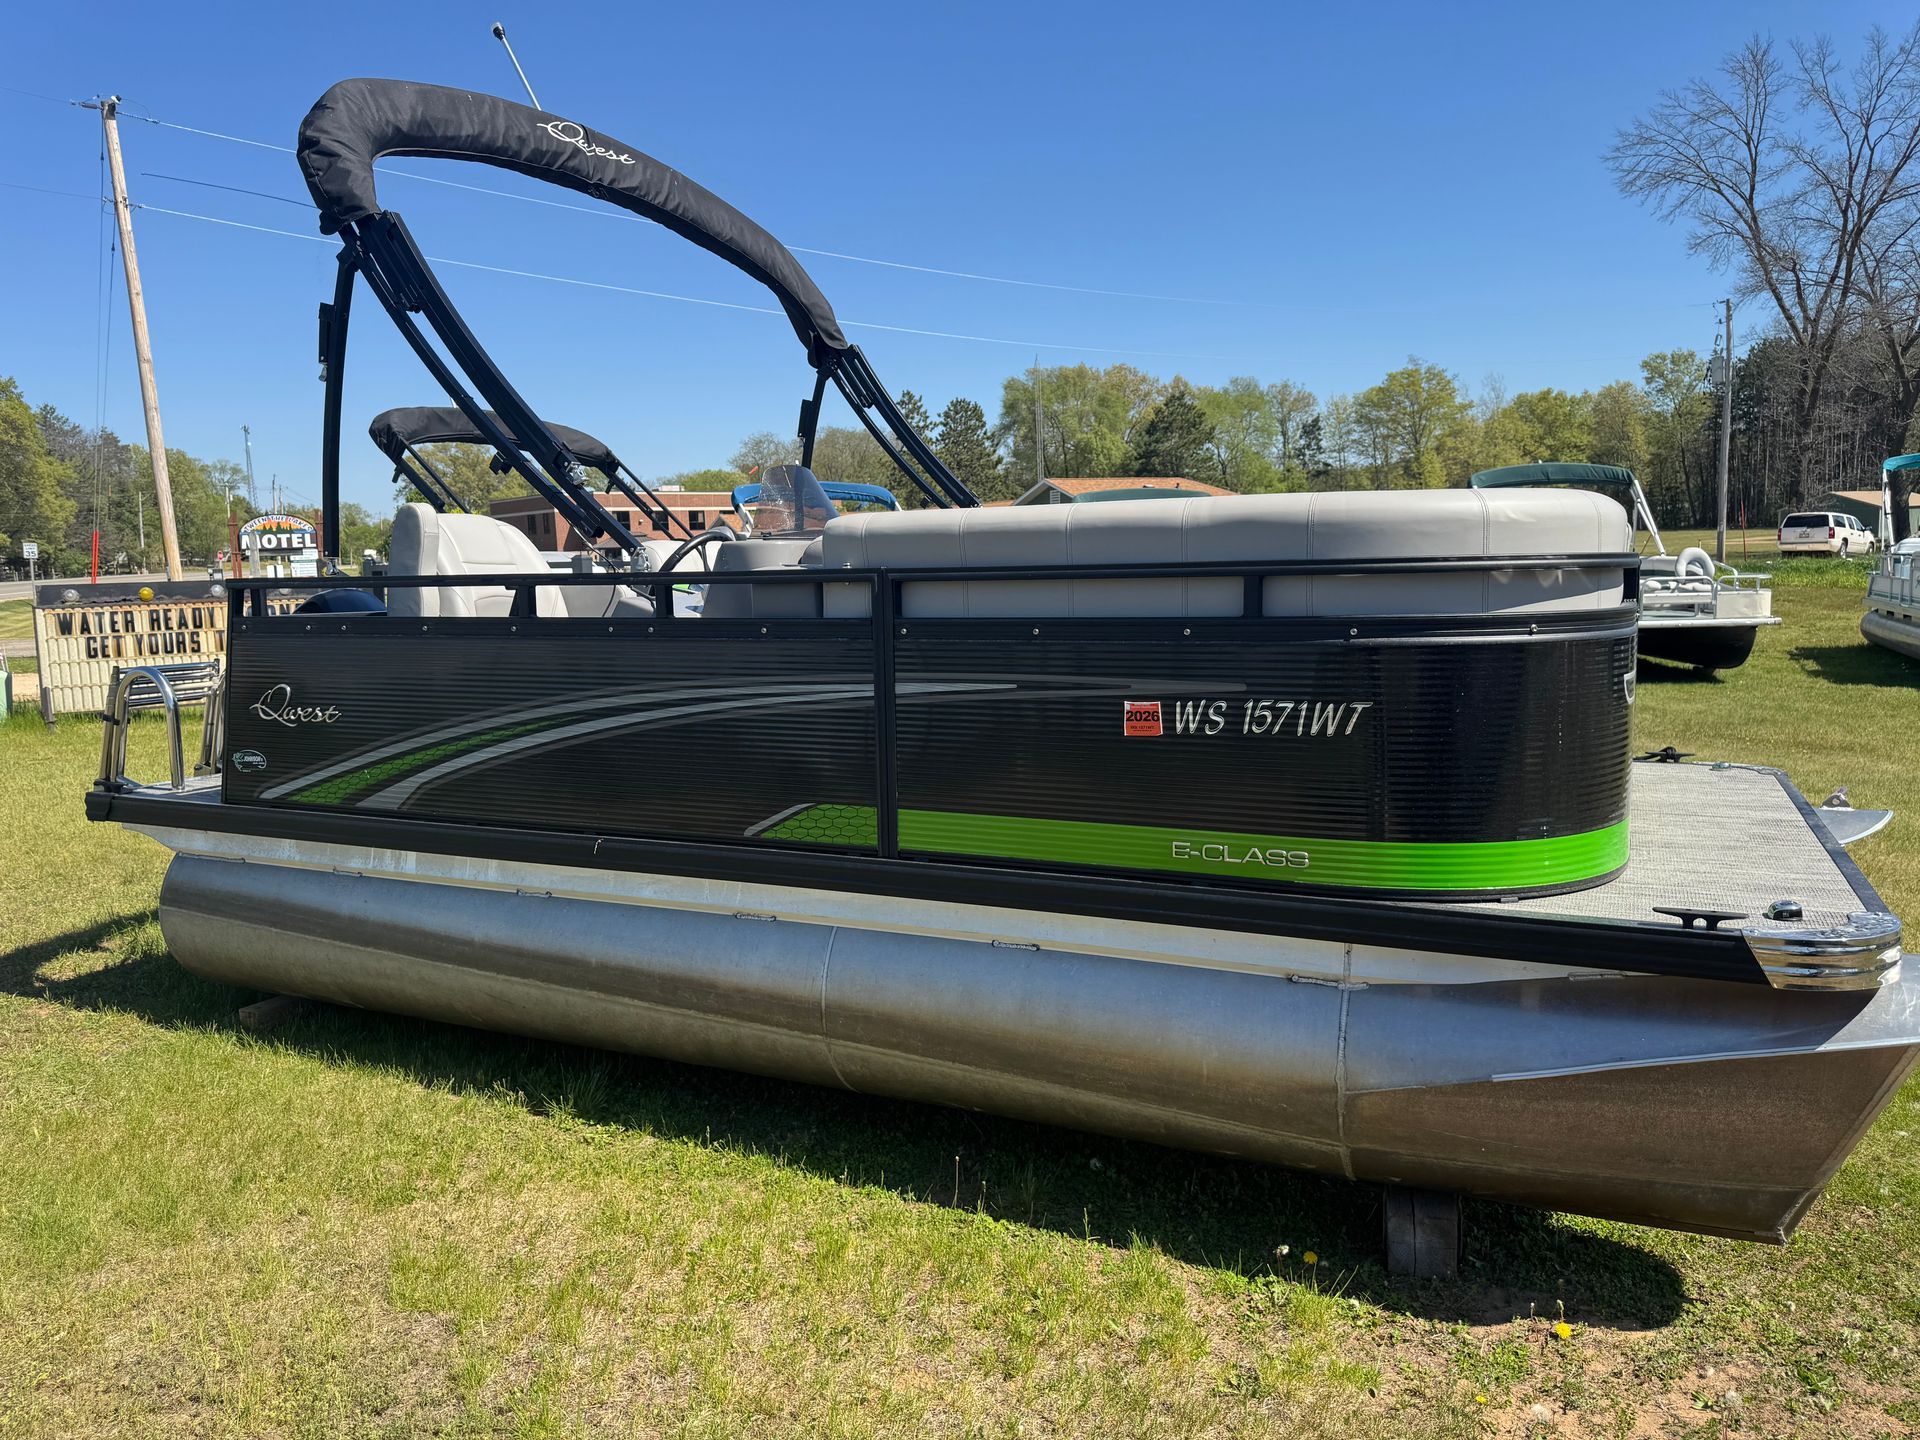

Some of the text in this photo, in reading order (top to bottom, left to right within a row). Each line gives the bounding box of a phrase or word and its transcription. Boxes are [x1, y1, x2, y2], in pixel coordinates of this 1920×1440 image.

[536, 121, 636, 164] Qwest
[25, 550, 37, 558] 35
[241, 533, 317, 549] MOTEL
[56, 610, 136, 635] WATER
[149, 607, 215, 631] READY
[86, 635, 123, 659] GET
[134, 631, 201, 656] YOURS
[249, 683, 342, 727] Qwest
[1125, 710, 1160, 722] 2026
[1175, 699, 1374, 737] WS 1571WT
[1172, 841, 1310, 869] E-CLASS
